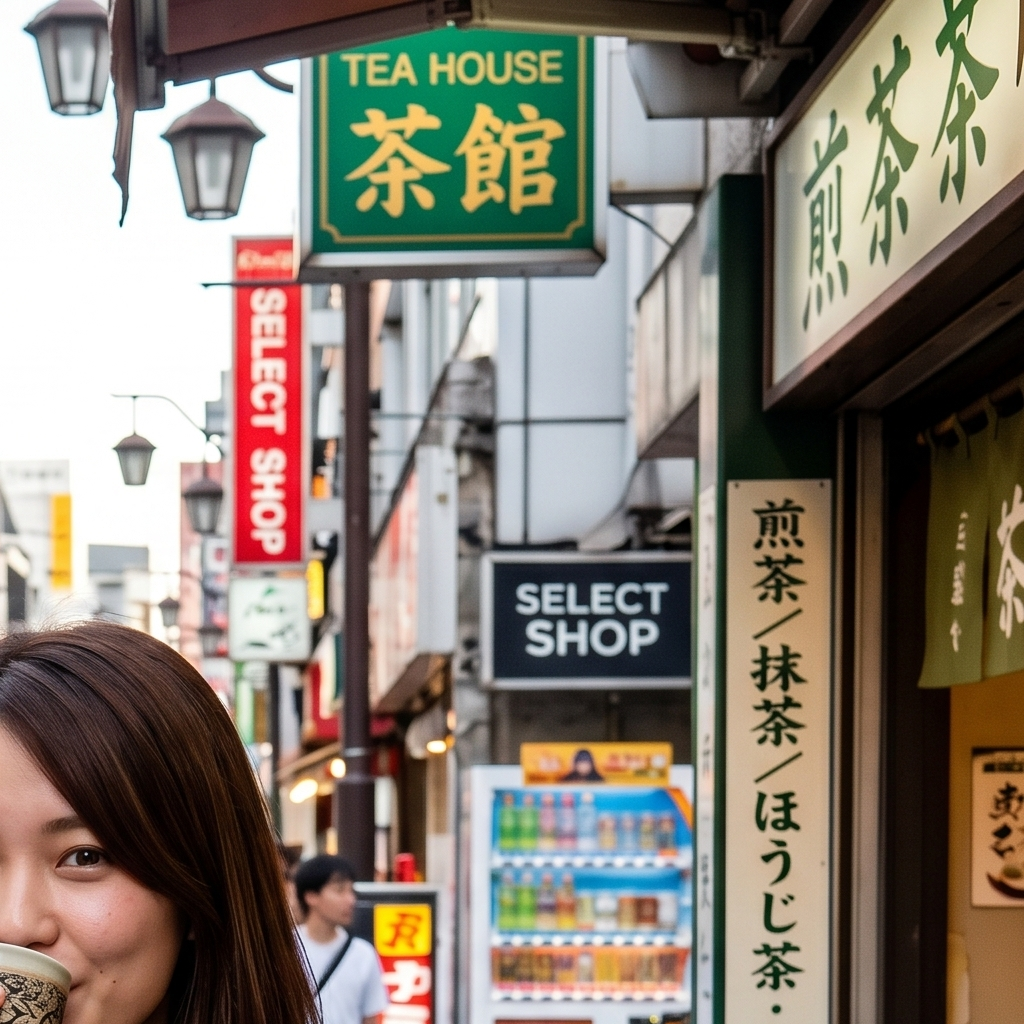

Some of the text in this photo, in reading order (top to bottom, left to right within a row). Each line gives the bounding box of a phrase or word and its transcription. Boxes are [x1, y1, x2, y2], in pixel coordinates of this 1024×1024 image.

[341, 50, 564, 87] TEA HOUSE
[344, 103, 567, 219] 茶館
[250, 286, 287, 434] SELECT
[250, 447, 287, 555] SHOP
[516, 583, 669, 615] SELECT
[525, 619, 660, 657] SHOP
